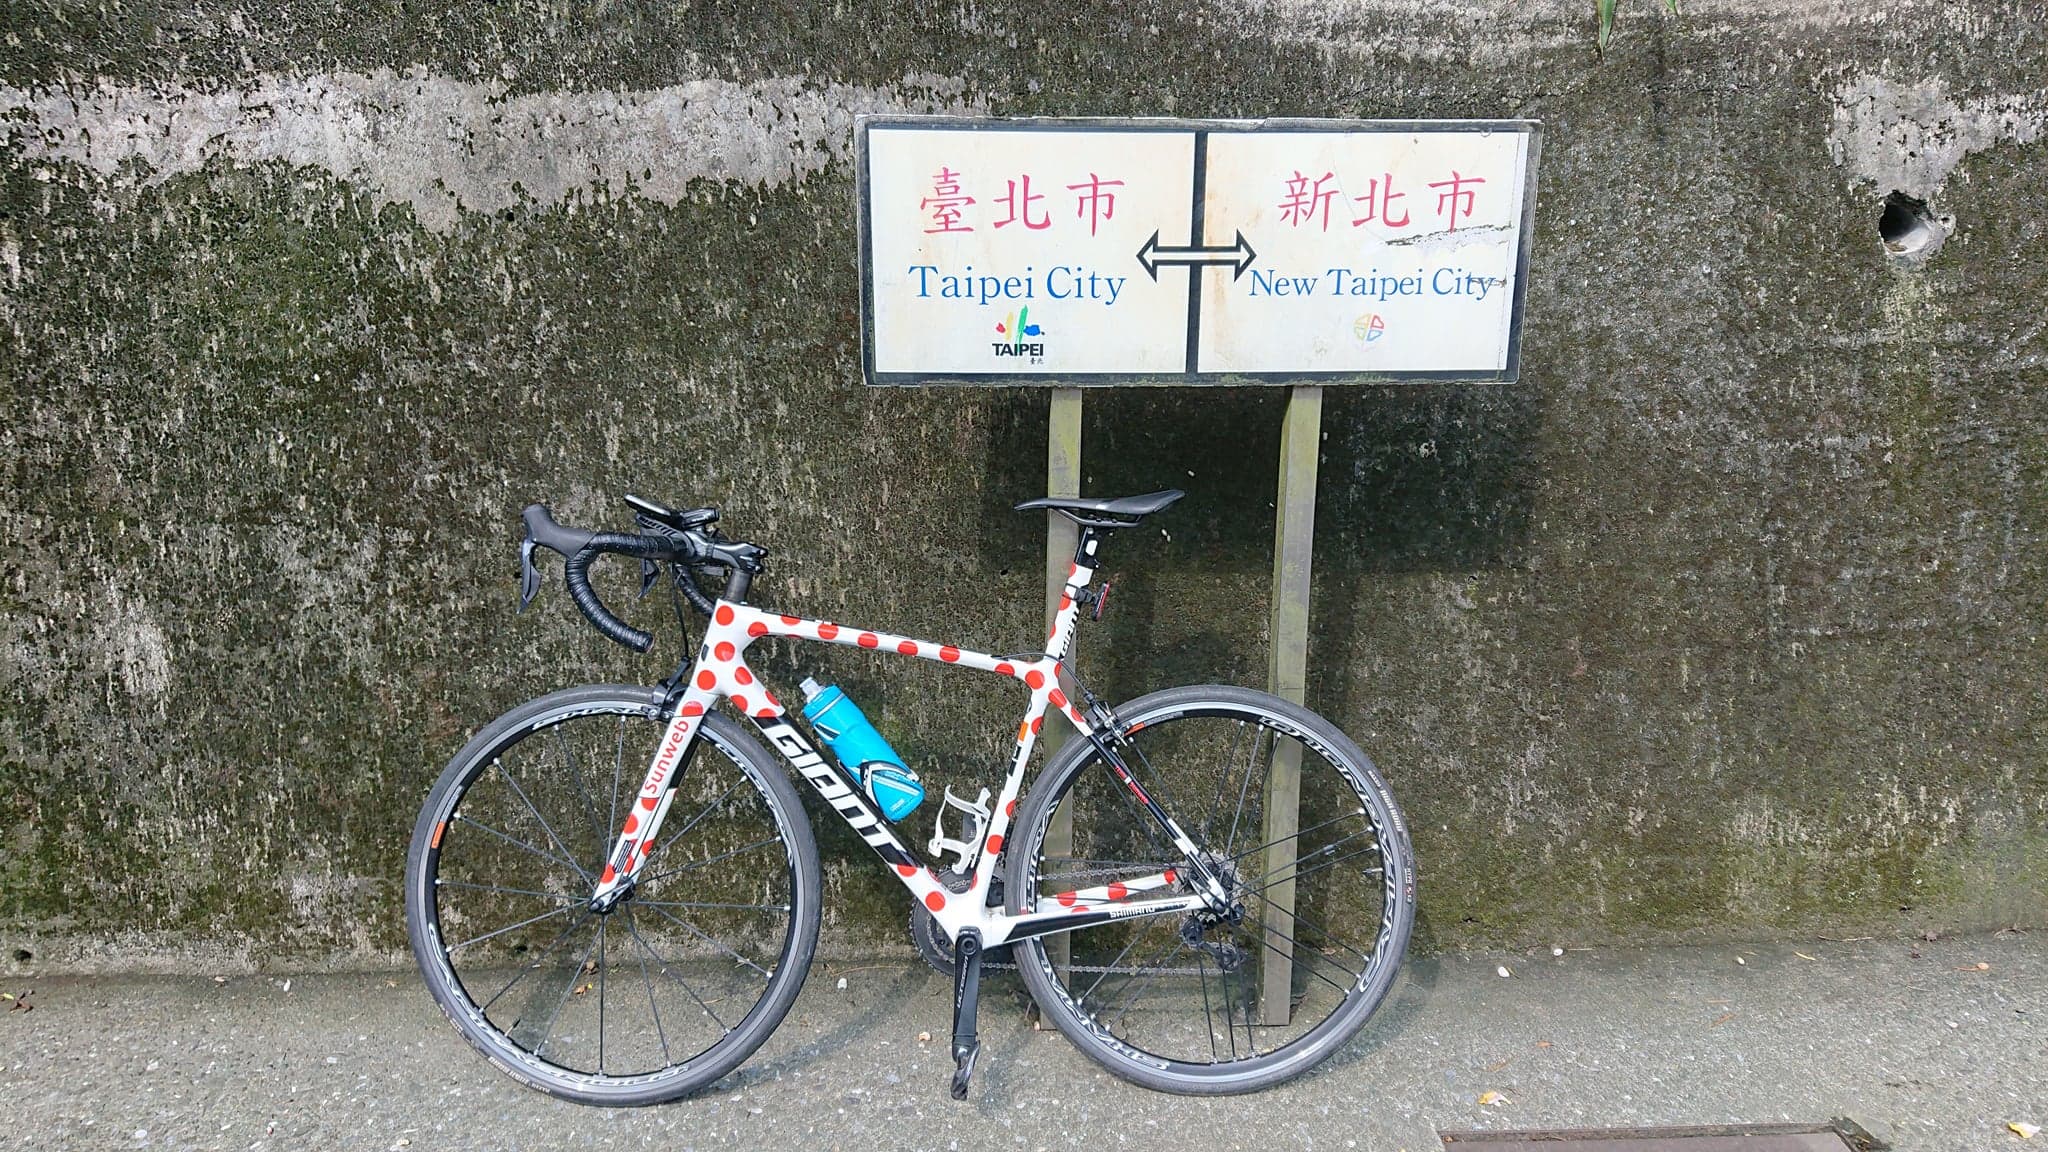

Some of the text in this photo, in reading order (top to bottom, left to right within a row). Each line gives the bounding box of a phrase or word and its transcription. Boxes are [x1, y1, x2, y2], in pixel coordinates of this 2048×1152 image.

[919, 167, 1125, 237] 臺北市
[1278, 170, 1486, 234] 新北市
[908, 265, 1127, 306] Taipei City
[1248, 268, 1497, 302] New Taipei City
[991, 343, 1044, 357] TAIPEI
[644, 720, 689, 795] Sunweb
[763, 723, 908, 853] GIANT
[1110, 905, 1155, 919] SHIMANO
